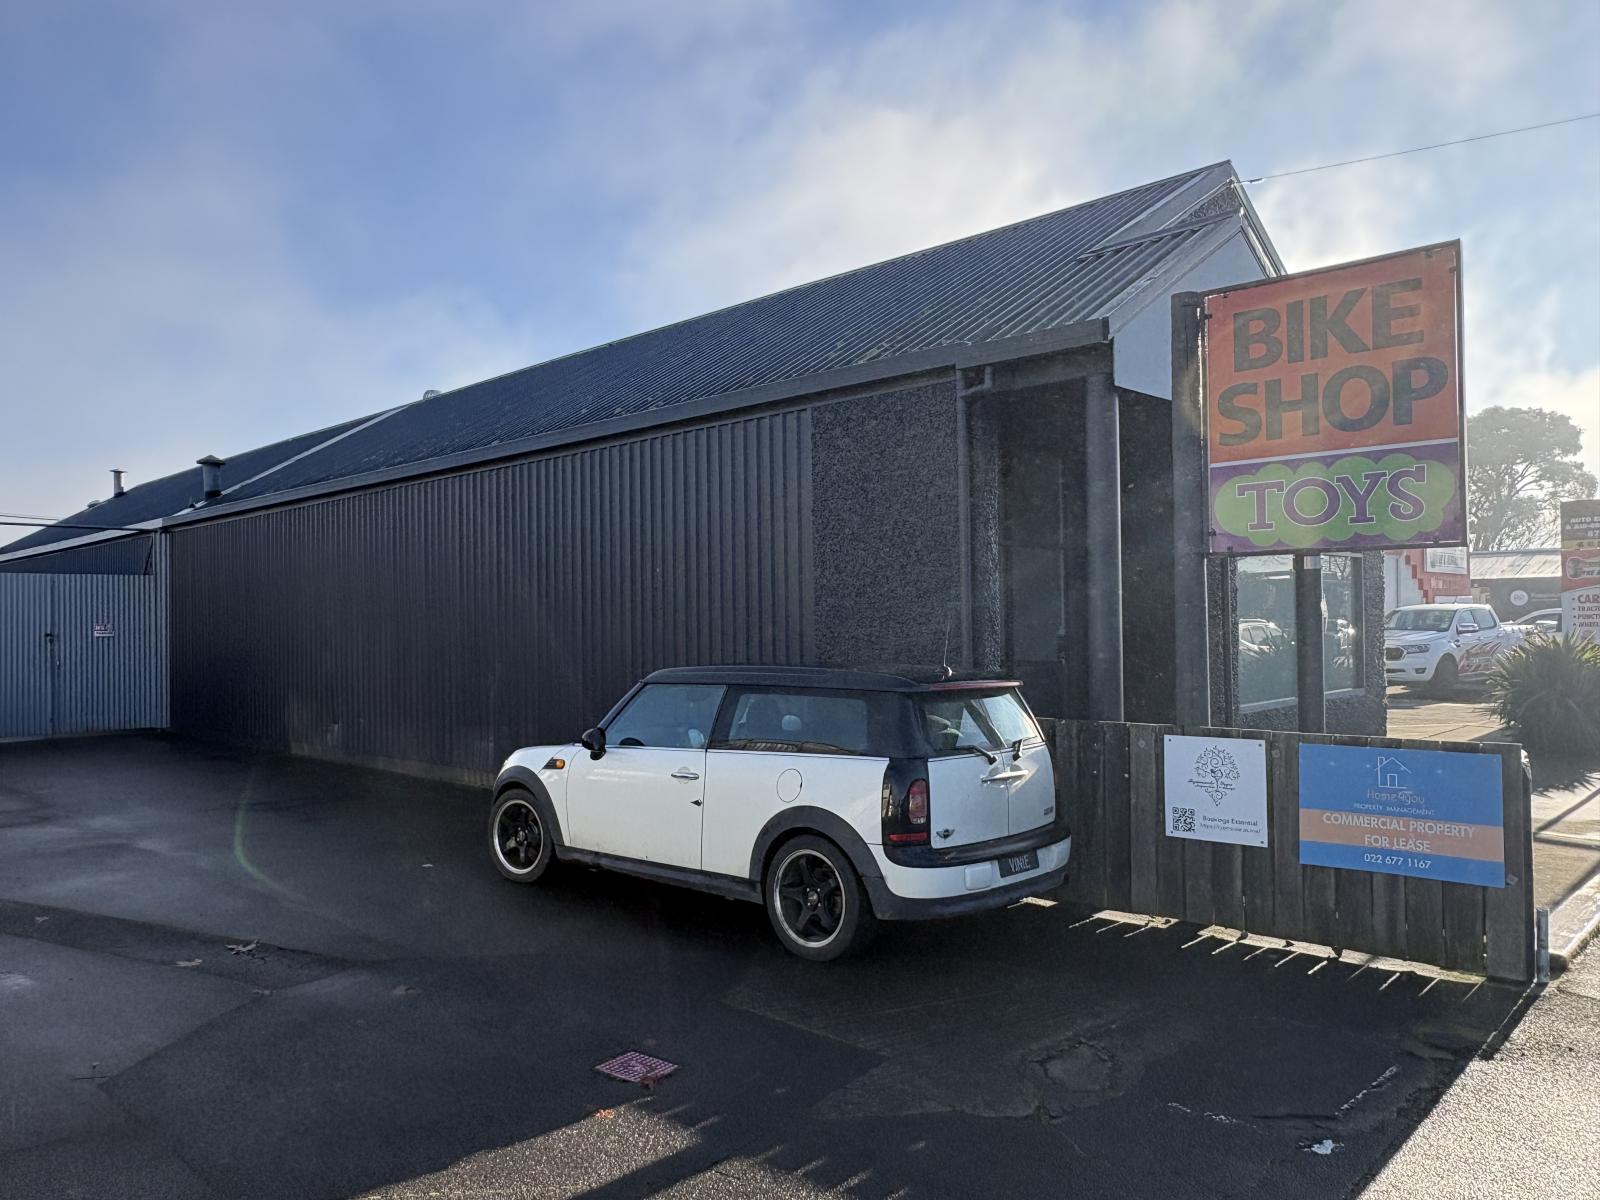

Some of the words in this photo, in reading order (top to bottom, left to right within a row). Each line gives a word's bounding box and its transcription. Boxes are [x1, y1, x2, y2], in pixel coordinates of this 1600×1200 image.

[1233, 277, 1425, 373] BIKE
[1218, 356, 1449, 446] SHOP
[1236, 464, 1427, 532] TOYS
[1353, 802, 1383, 811] PROPERTY
[1386, 805, 1435, 816] MANAGEMENT
[1322, 812, 1406, 832] COMMERCIAL
[1409, 820, 1475, 839] PROPERTY
[1364, 834, 1389, 848] FOR
[1393, 837, 1431, 852] LEASE
[1364, 853, 1383, 864] 022
[1385, 855, 1403, 866] 677
[1407, 857, 1432, 869] 1167
